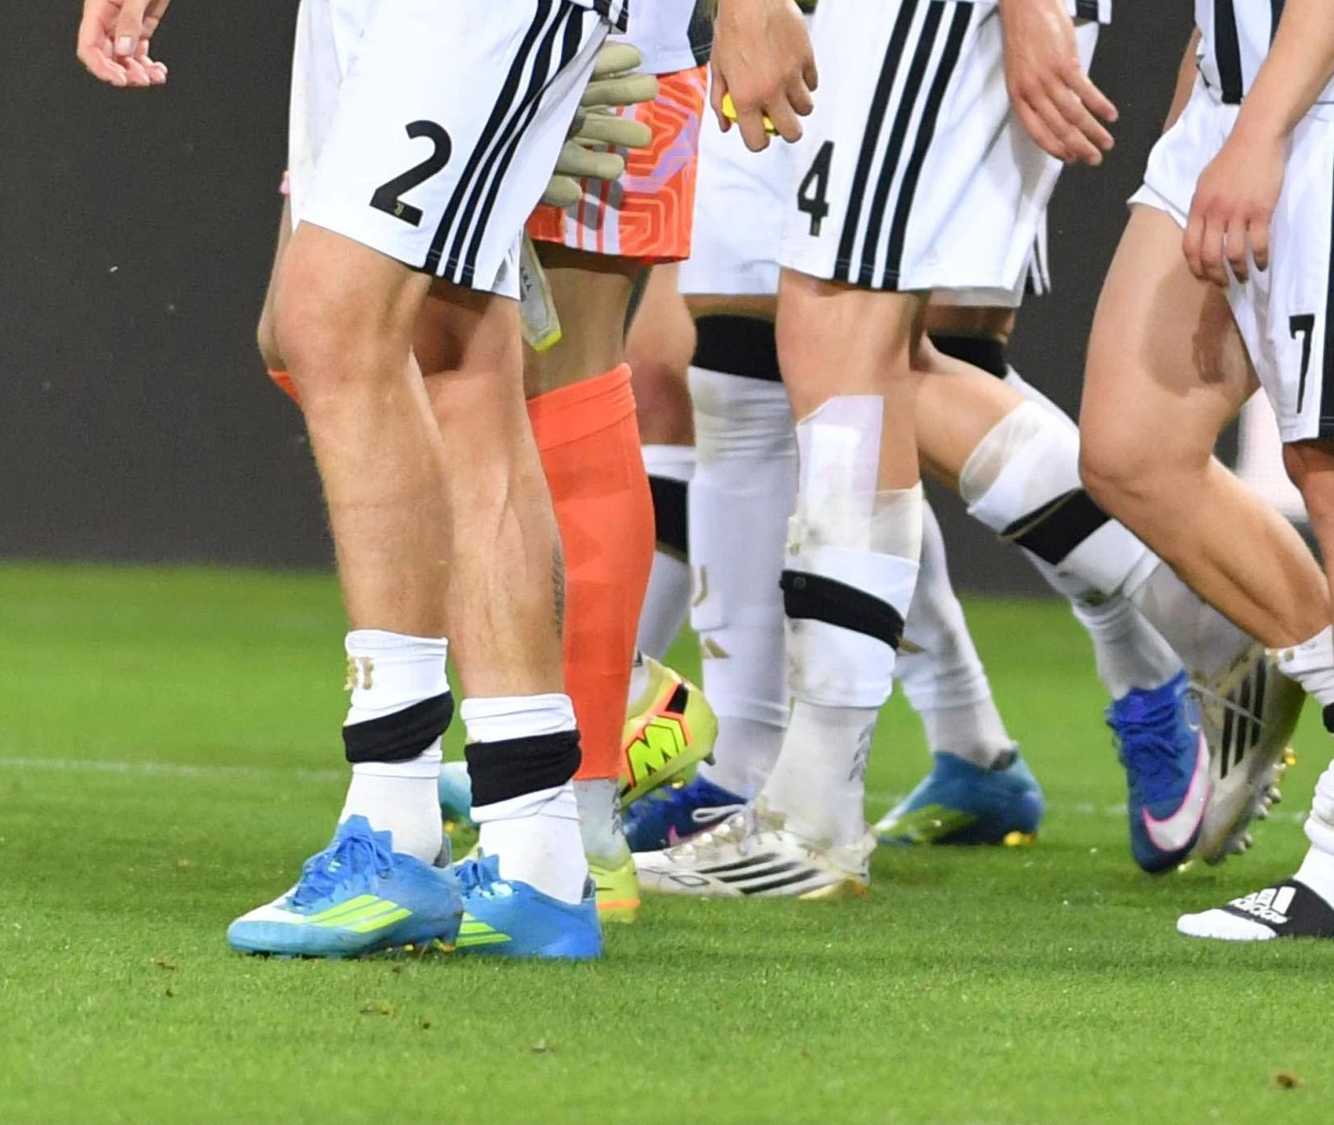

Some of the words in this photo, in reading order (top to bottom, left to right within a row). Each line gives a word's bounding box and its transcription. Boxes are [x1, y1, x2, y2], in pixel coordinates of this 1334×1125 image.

[369, 119, 452, 228] 2
[797, 140, 835, 238] 4
[1289, 313, 1315, 414] 7
